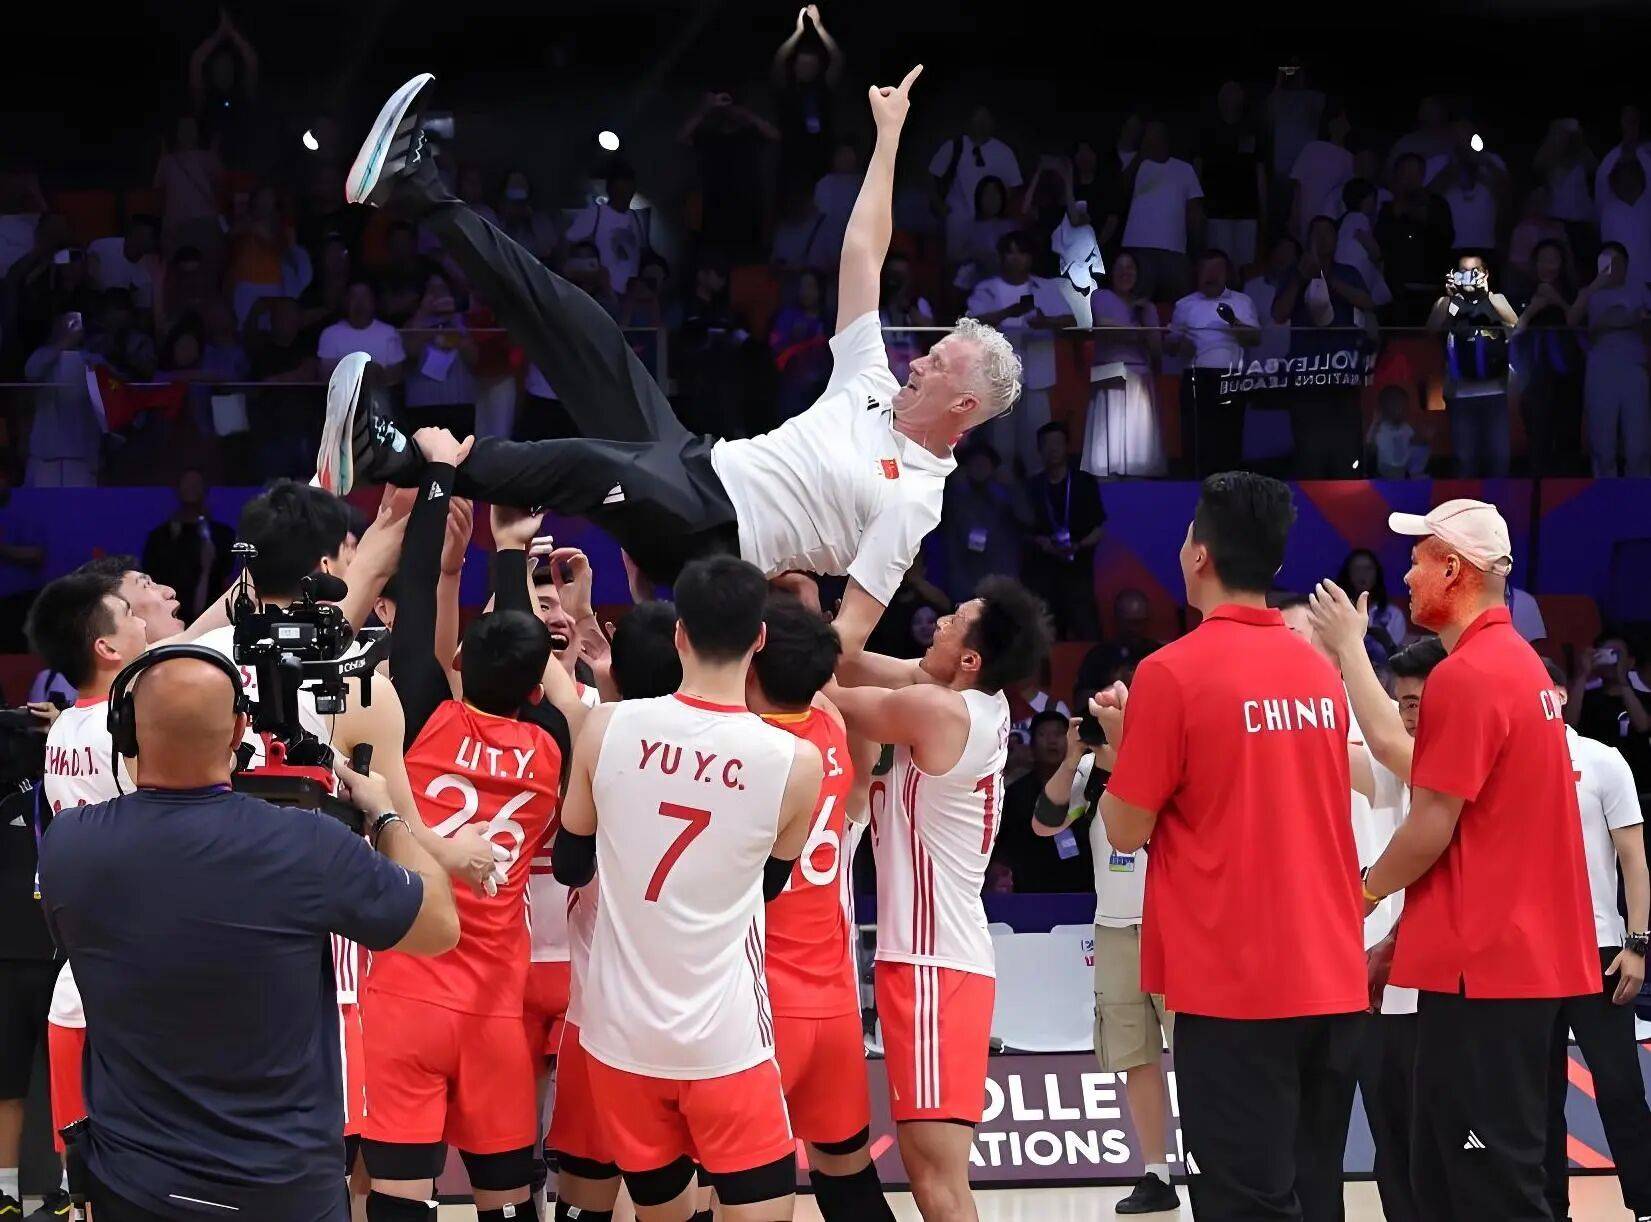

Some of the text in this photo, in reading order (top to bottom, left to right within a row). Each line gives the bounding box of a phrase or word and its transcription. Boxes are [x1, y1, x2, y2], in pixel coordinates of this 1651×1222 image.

[1243, 697, 1336, 733] CHINA
[639, 739, 683, 775] YU
[424, 773, 537, 885] 26
[644, 801, 712, 903] 7
